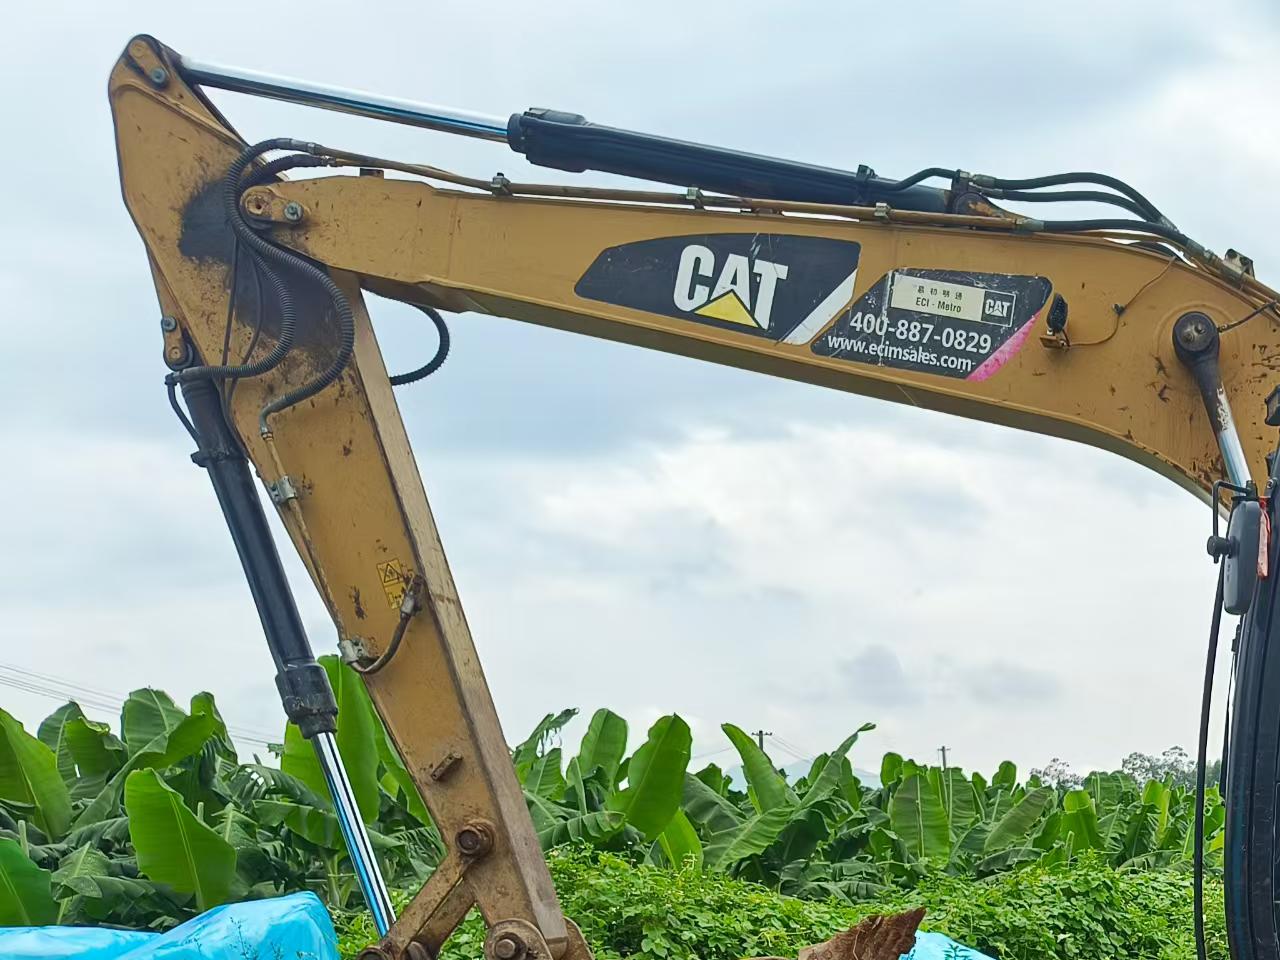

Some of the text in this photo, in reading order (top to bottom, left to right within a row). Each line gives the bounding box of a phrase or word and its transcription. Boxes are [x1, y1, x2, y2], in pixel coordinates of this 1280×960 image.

[673, 244, 788, 330] CAT
[984, 299, 1011, 317] CAT
[850, 312, 992, 354] 400-887-0829
[827, 335, 973, 372] www.ecimsales.com
